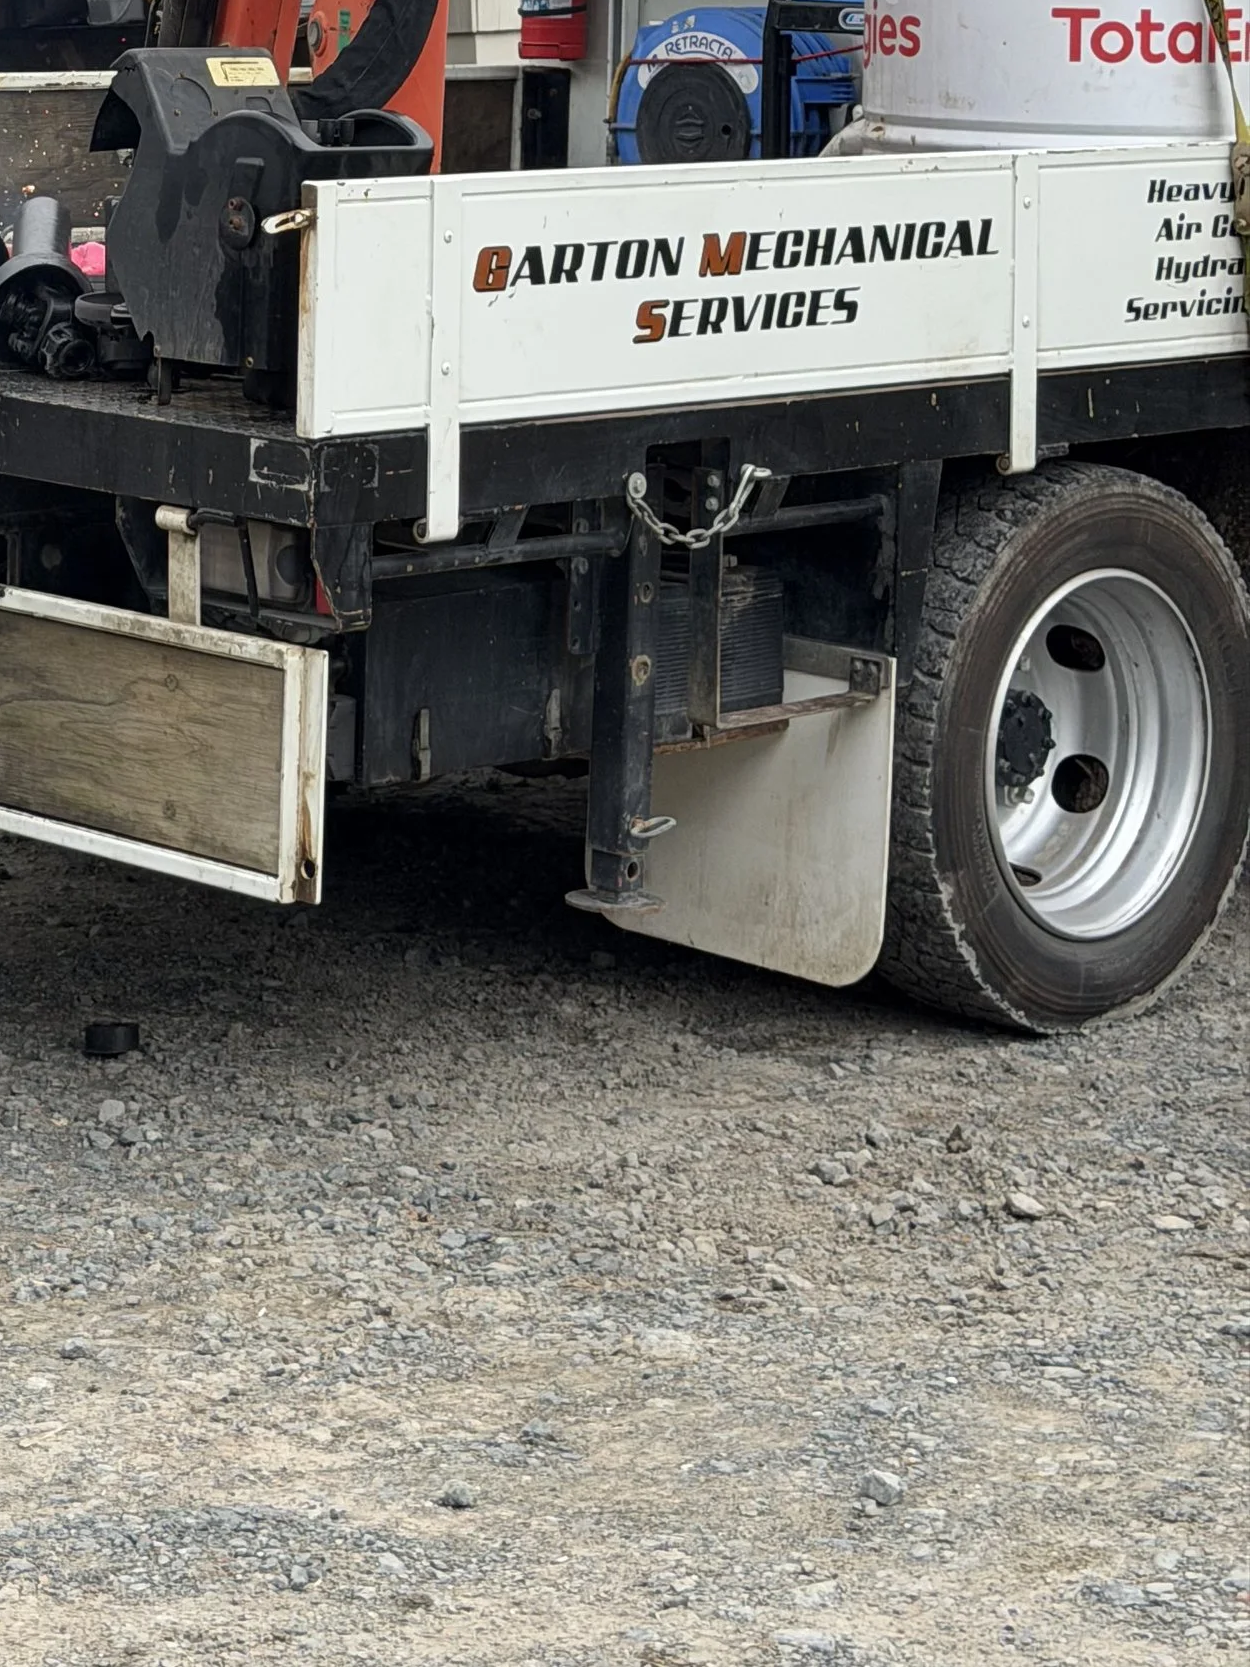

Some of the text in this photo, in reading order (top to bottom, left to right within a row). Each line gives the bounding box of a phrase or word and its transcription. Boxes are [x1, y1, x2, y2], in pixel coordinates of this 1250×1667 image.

[1147, 179, 1236, 204] Heavy
[1155, 212, 1203, 243] Air
[473, 218, 999, 293] GARTON MECHANICAL
[632, 286, 861, 344] SERVICES
